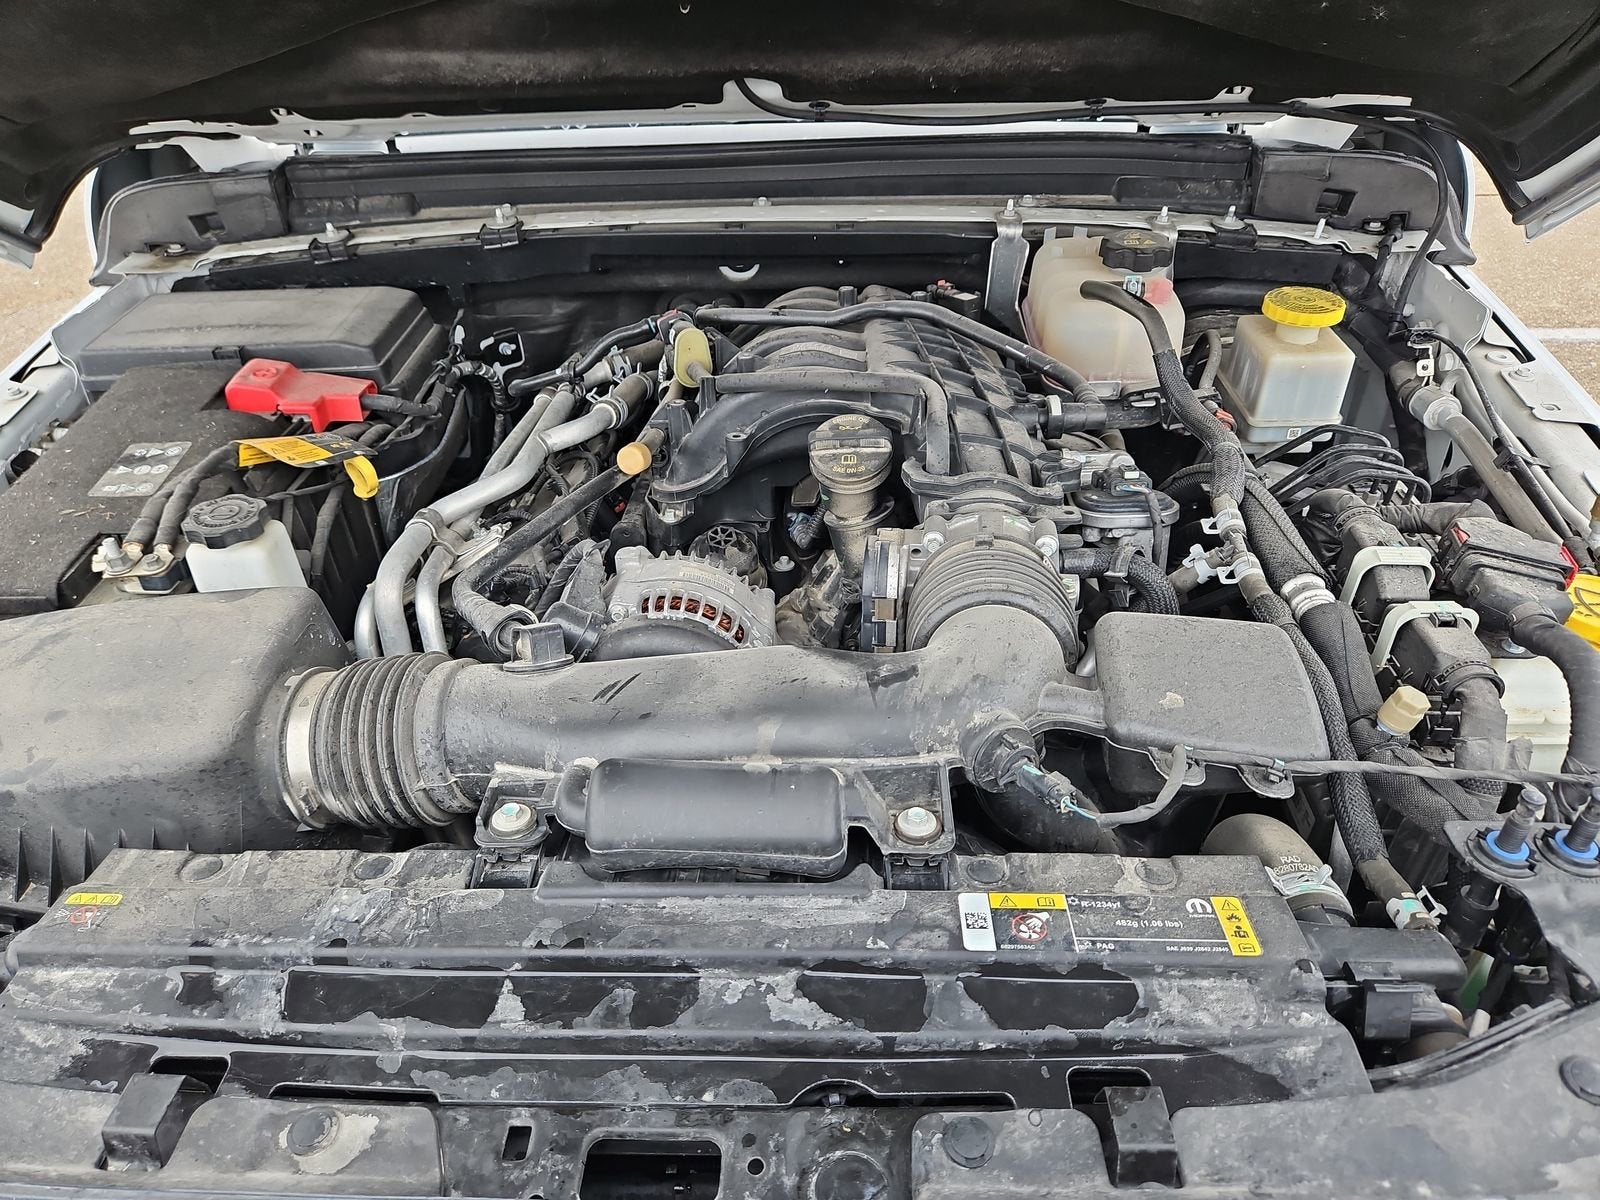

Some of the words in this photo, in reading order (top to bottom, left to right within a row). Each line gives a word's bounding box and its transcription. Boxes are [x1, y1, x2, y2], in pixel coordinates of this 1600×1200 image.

[832, 465, 846, 473] SAE
[1280, 855, 1301, 864] RAD
[1115, 919, 1139, 928] 482g
[1140, 920, 1163, 928] (1.06
[1165, 920, 1184, 928] lbs)
[1096, 942, 1115, 950] PAG
